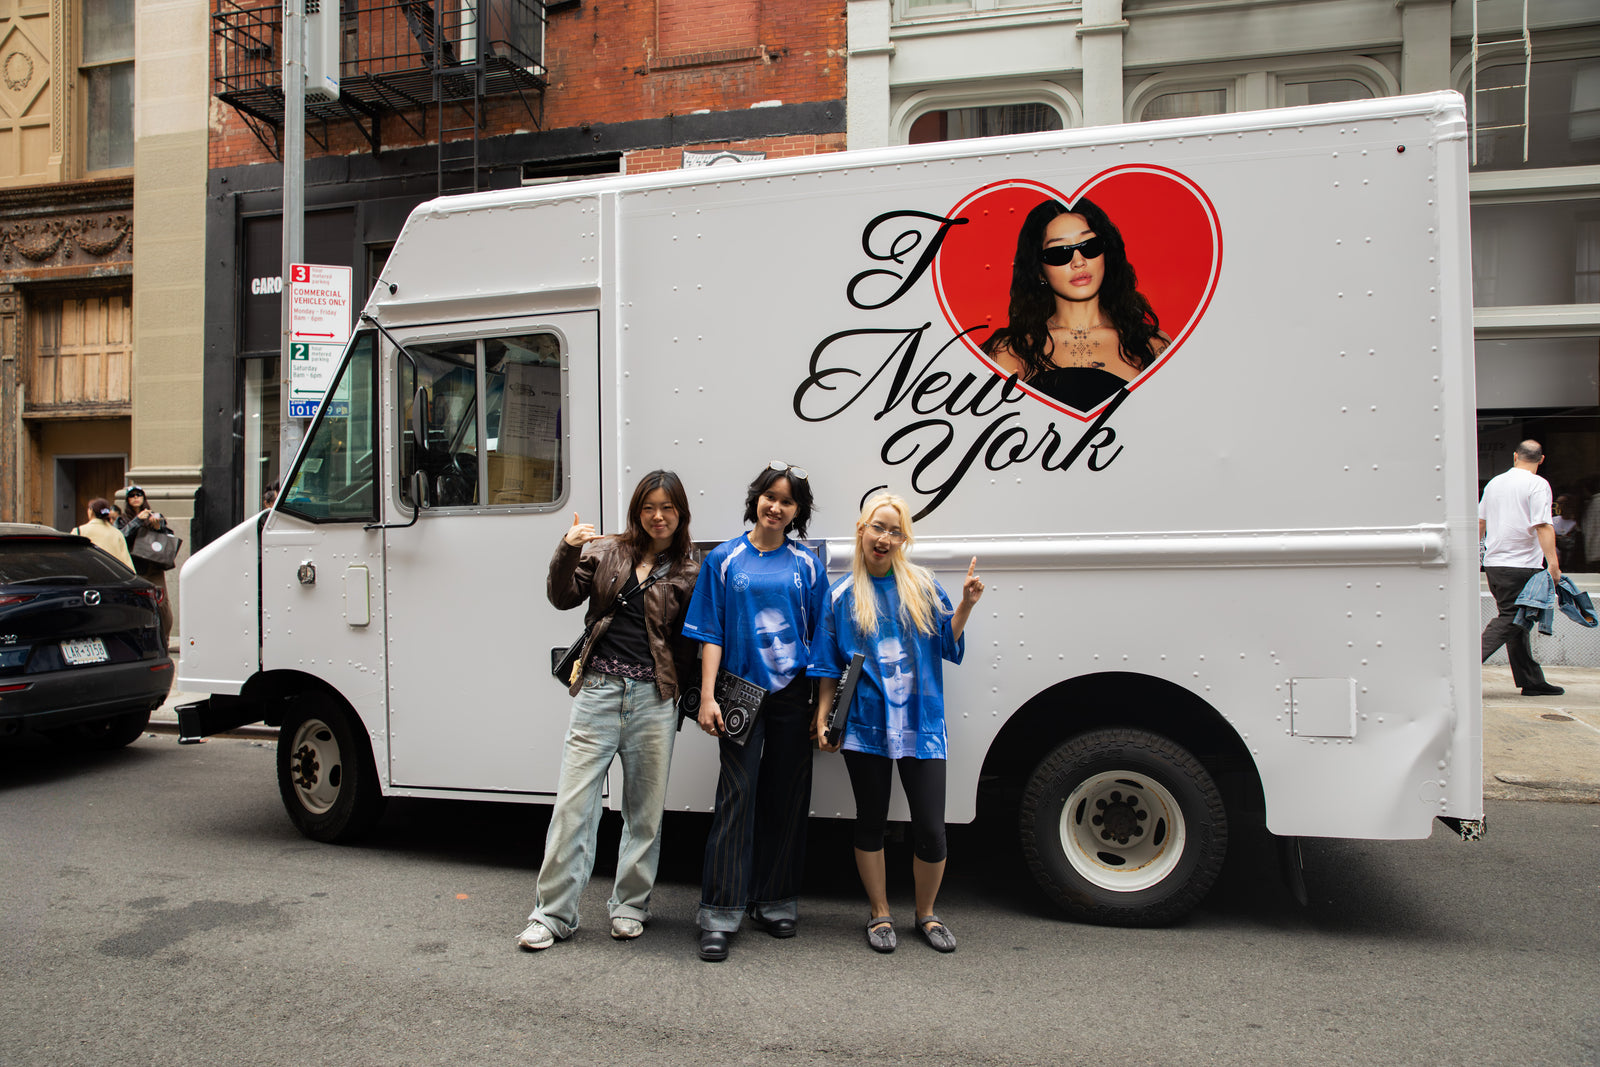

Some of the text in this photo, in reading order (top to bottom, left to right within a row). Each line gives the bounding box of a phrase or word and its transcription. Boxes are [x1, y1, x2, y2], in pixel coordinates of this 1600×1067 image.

[296, 266, 306, 281] 3
[251, 276, 282, 295] CARO
[294, 288, 342, 297] COMMERCIAL
[294, 297, 346, 306] VEHICLES ONLY
[293, 307, 315, 316] Monday
[320, 308, 337, 317] Friday
[295, 344, 305, 359] 2
[293, 364, 317, 372] Saturday
[793, 321, 1026, 422] New
[860, 387, 1131, 523] York
